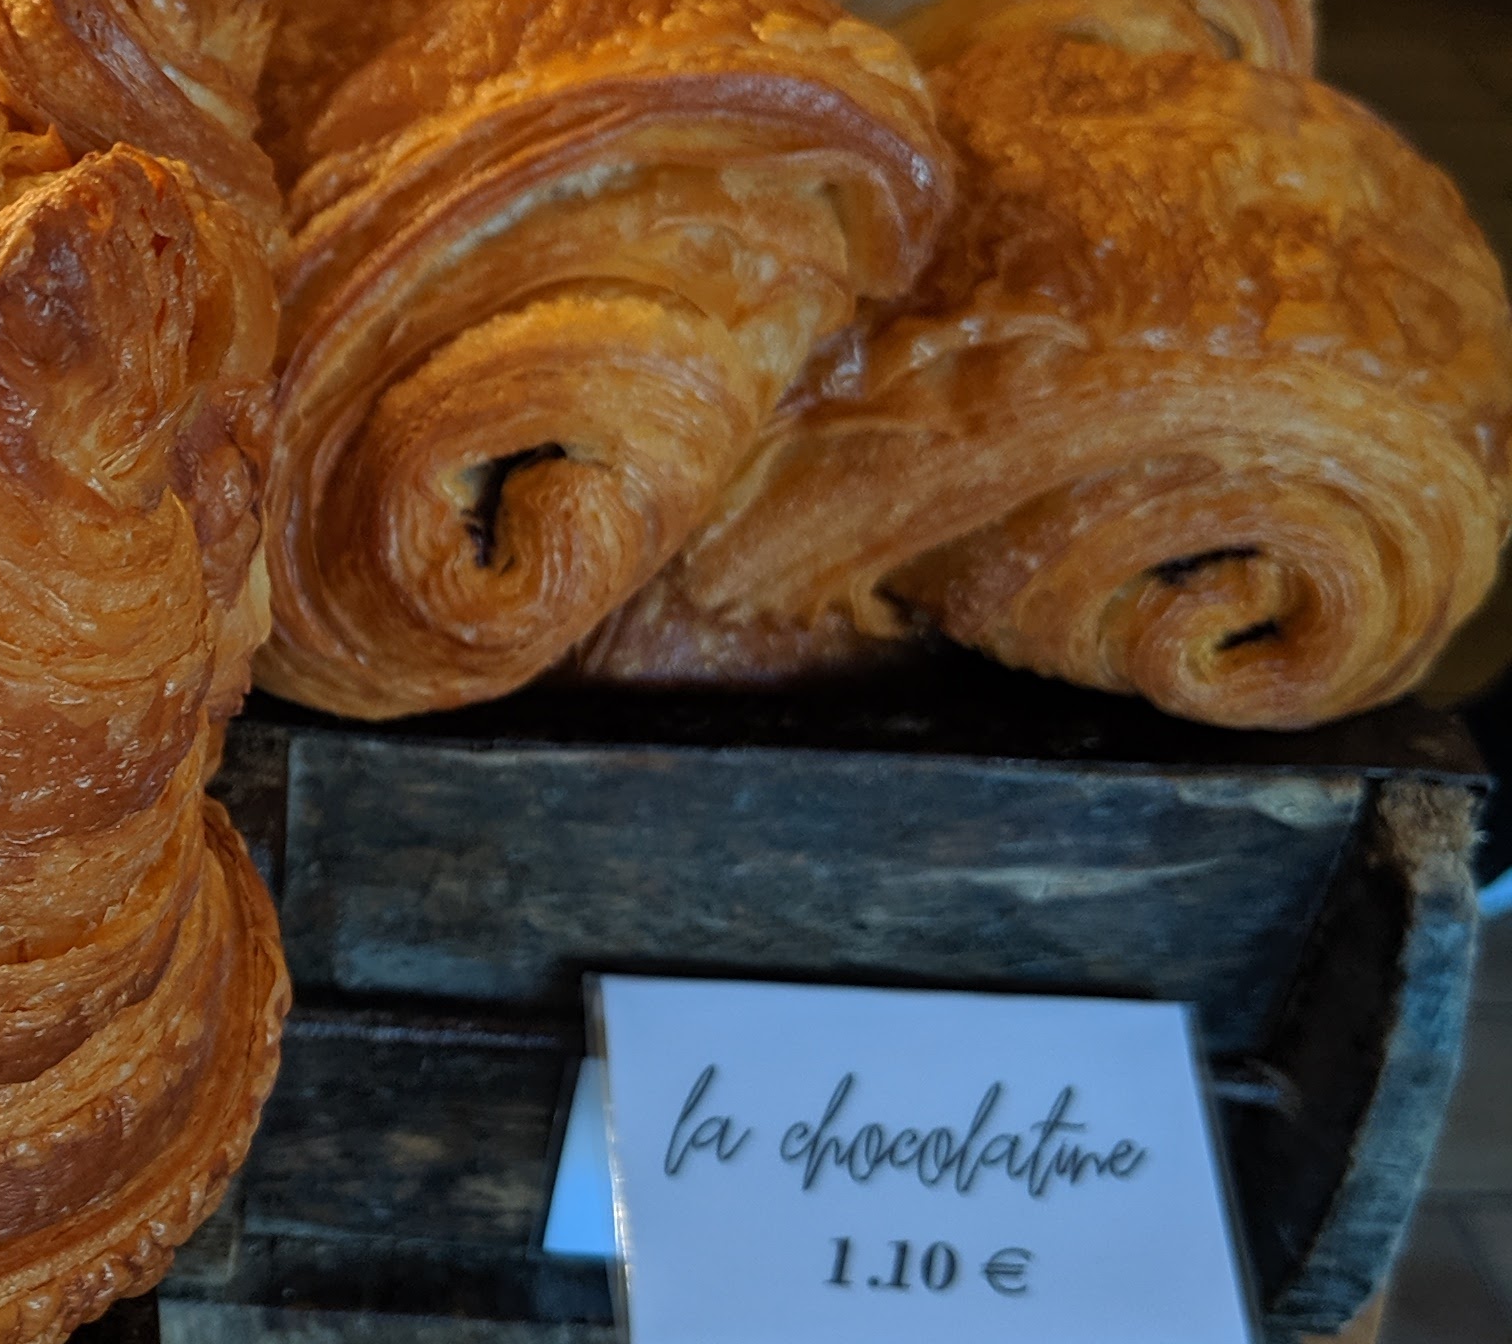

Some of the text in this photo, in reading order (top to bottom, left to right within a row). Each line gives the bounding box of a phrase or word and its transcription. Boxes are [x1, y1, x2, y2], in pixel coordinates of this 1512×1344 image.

[662, 1062, 1148, 1200] la chocolatine
[822, 1235, 1034, 1298] 1.10 €
